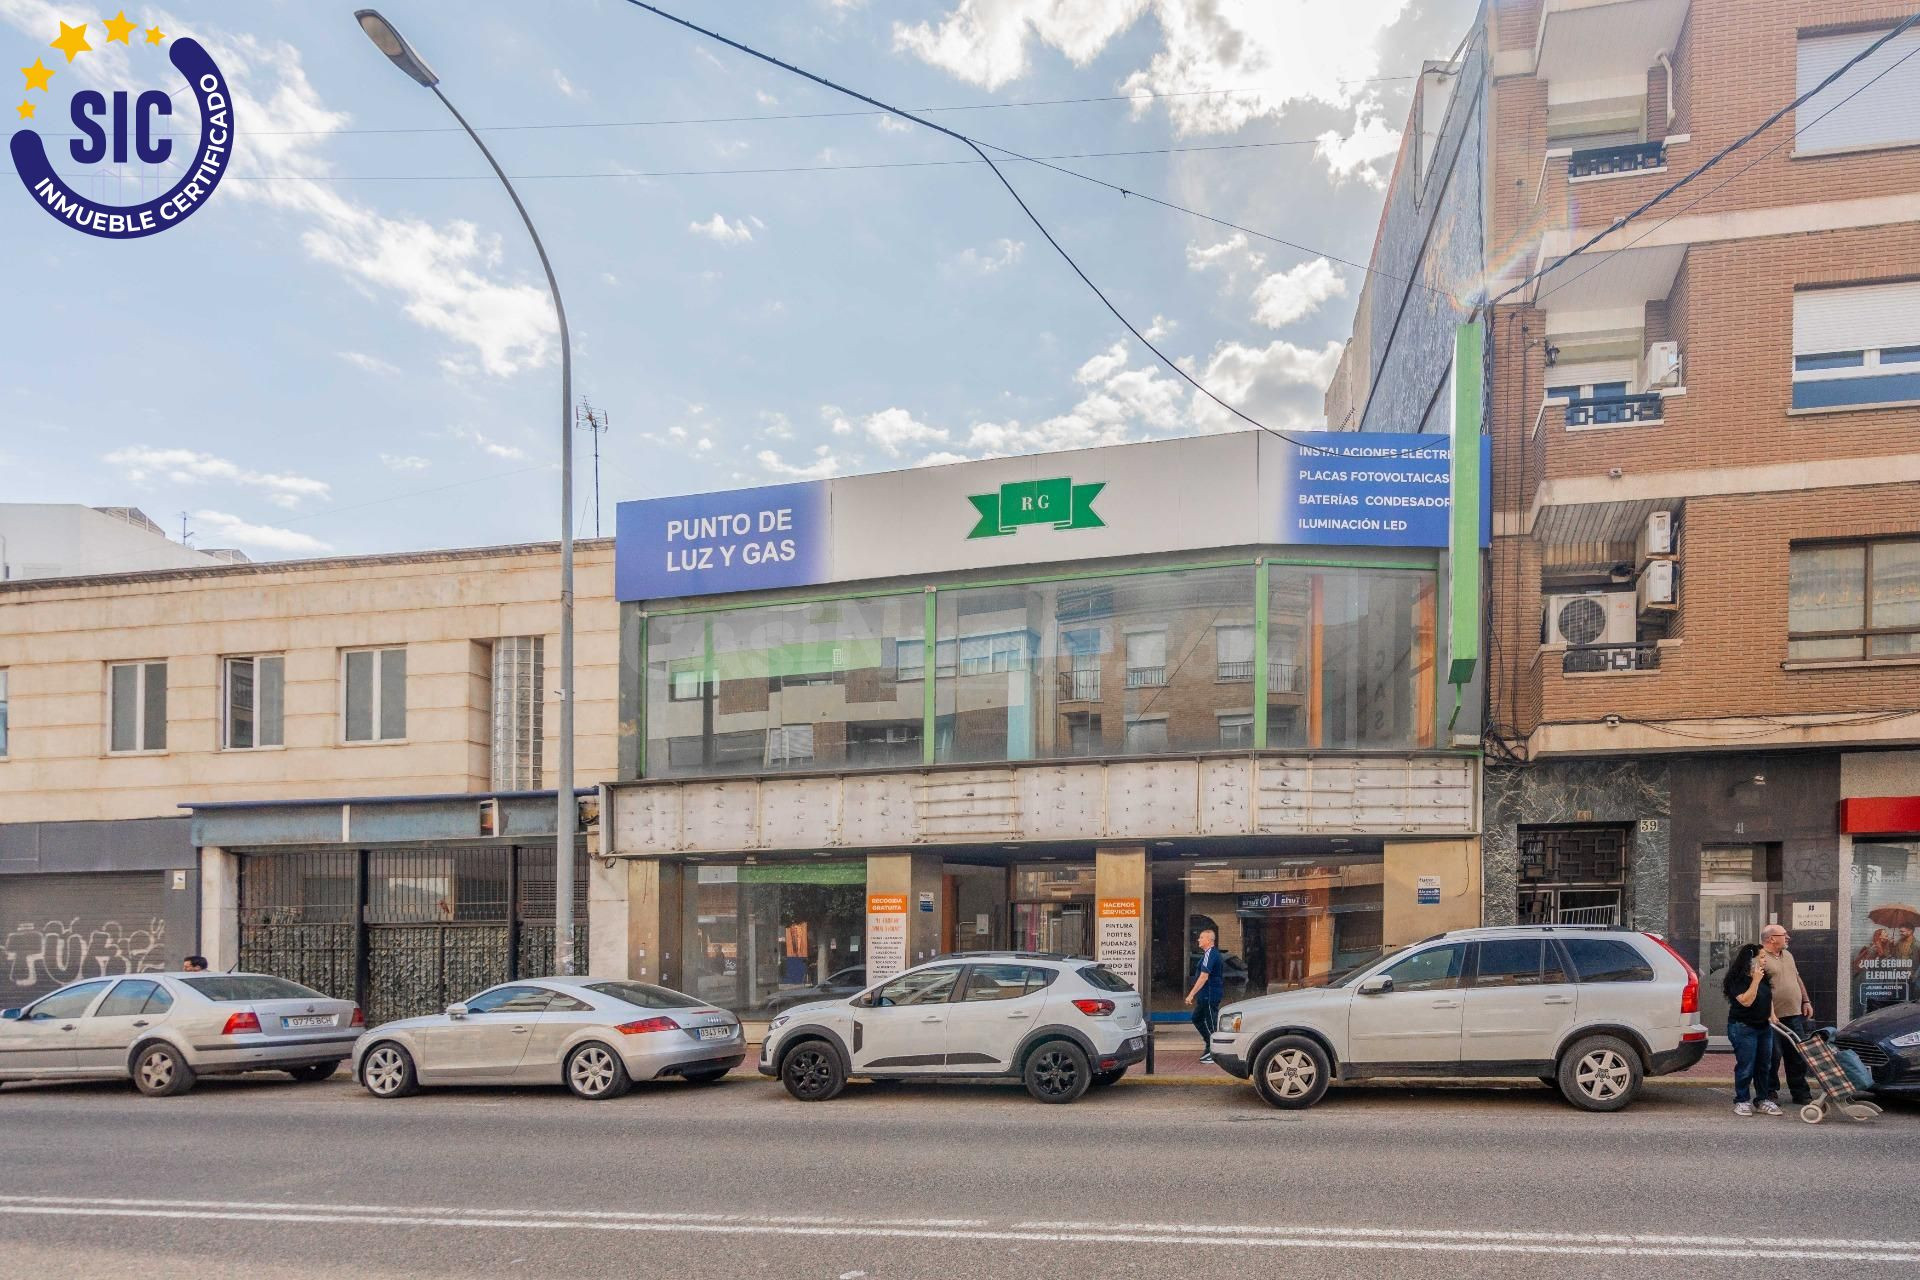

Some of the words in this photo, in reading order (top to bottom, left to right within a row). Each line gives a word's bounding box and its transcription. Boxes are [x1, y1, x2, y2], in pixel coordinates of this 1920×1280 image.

[1300, 446, 1397, 458] INSTALACIONES
[1299, 470, 1347, 482] PLACAS
[1351, 472, 1450, 484] FOTOVOLTAICAS
[1299, 493, 1358, 506] BATERÍAS
[667, 512, 751, 542] PUNTO
[759, 508, 793, 533] DE
[1299, 518, 1380, 530] ILUMINACIÓN
[1383, 520, 1407, 531] LED
[667, 547, 714, 572] LUZ
[719, 544, 736, 567] Y
[742, 539, 796, 565] GAS
[1641, 820, 1657, 832] 39
[1734, 822, 1745, 834] 41
[1858, 957, 1880, 969] ¿QUÉ
[1880, 959, 1913, 968] SEGURO
[1865, 969, 1912, 980] ELEGIRÍAS?
